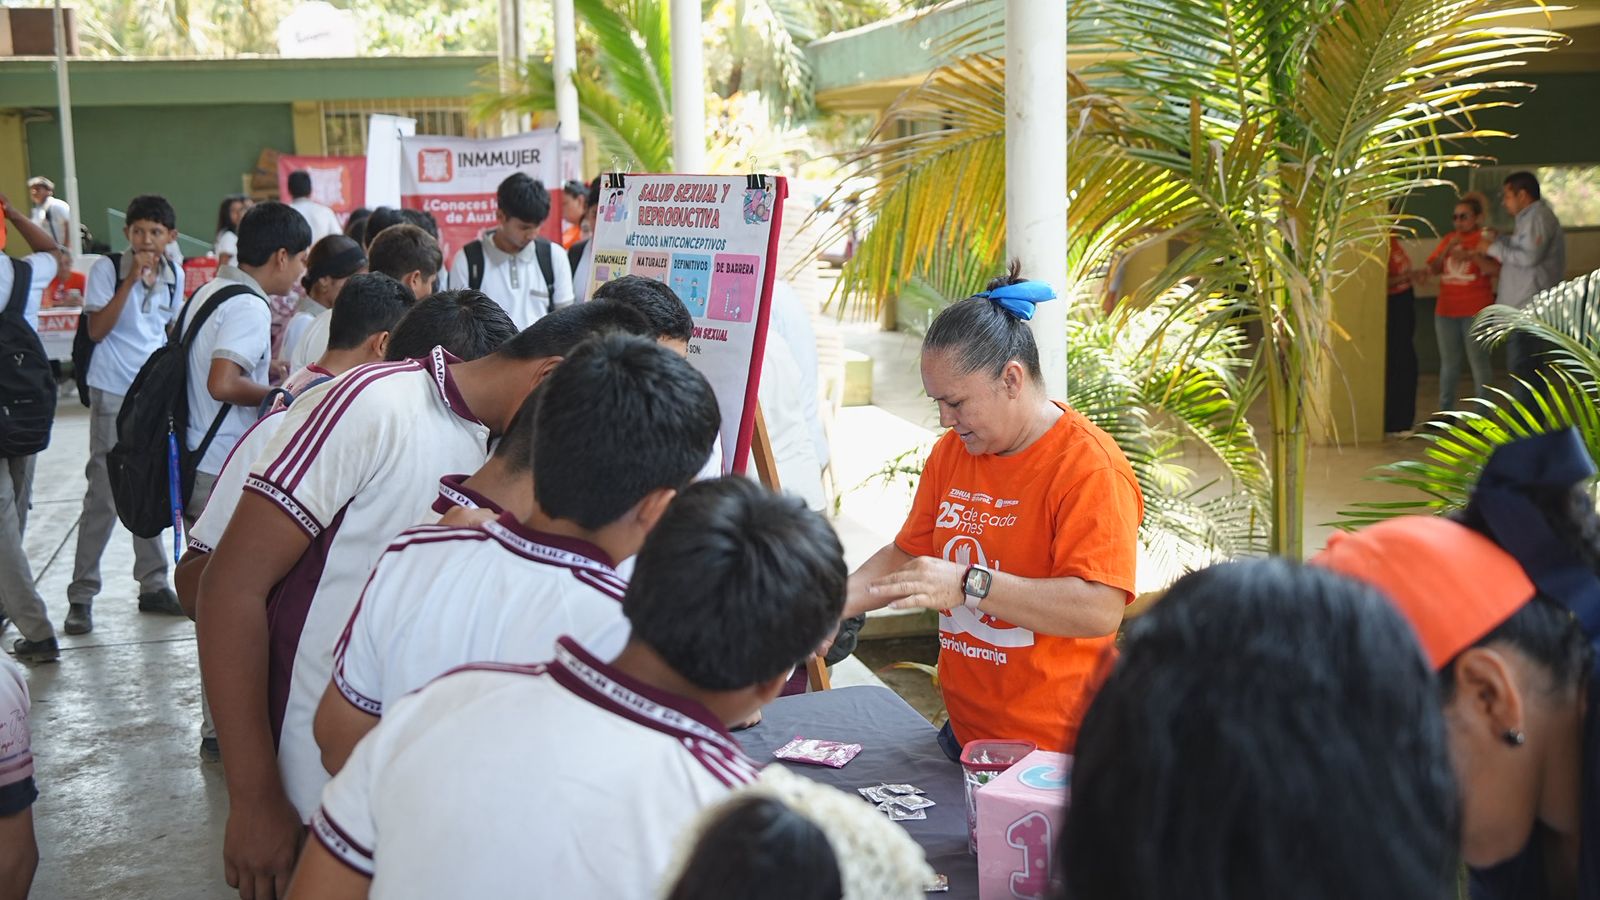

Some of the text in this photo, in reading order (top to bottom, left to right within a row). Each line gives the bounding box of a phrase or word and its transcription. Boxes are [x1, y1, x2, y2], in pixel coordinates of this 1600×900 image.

[458, 149, 541, 168] INMMUJER
[638, 183, 731, 203] SALUD SEXUAL Y
[423, 198, 488, 212] ¿Conoces
[446, 210, 497, 224] de Auxi
[638, 206, 720, 229] REPRODUCTIVA
[625, 231, 727, 251] MÉTODOS ANTICONCEPTIVOS
[594, 254, 628, 266] HORMONALES
[636, 256, 668, 268] NATURALES
[673, 259, 708, 271] DEFINITIVOS
[715, 262, 755, 275] DE BARRERA
[703, 327, 728, 341] SEXUAL
[251, 480, 279, 497] JOSE
[936, 501, 1018, 529] 25 de cada
[955, 520, 984, 535] mes
